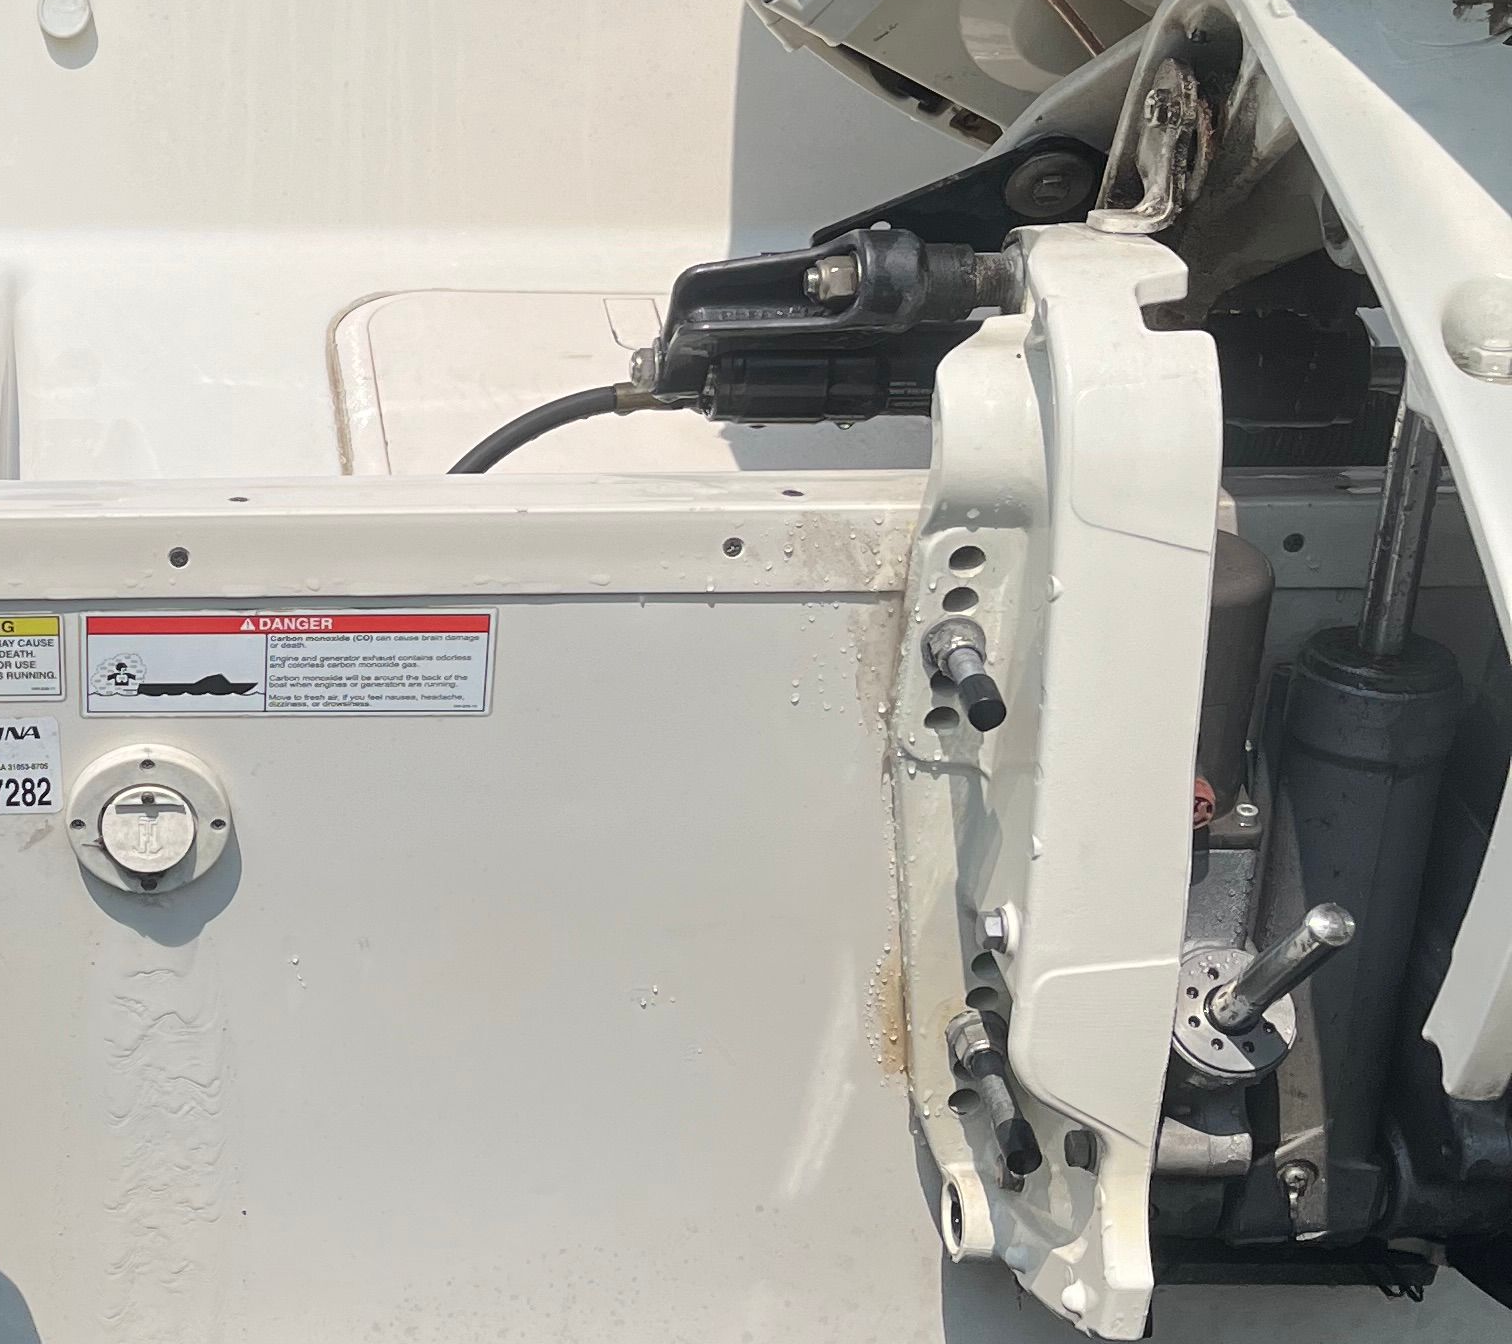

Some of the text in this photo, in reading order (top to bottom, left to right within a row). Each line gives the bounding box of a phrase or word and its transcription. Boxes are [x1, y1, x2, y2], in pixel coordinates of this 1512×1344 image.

[259, 617, 333, 630] DANGER
[17, 638, 54, 647] CAUSE
[353, 634, 373, 642] (CO)
[269, 655, 299, 663] Engine
[14, 660, 37, 669] USE
[6, 670, 57, 680] RUNNING.
